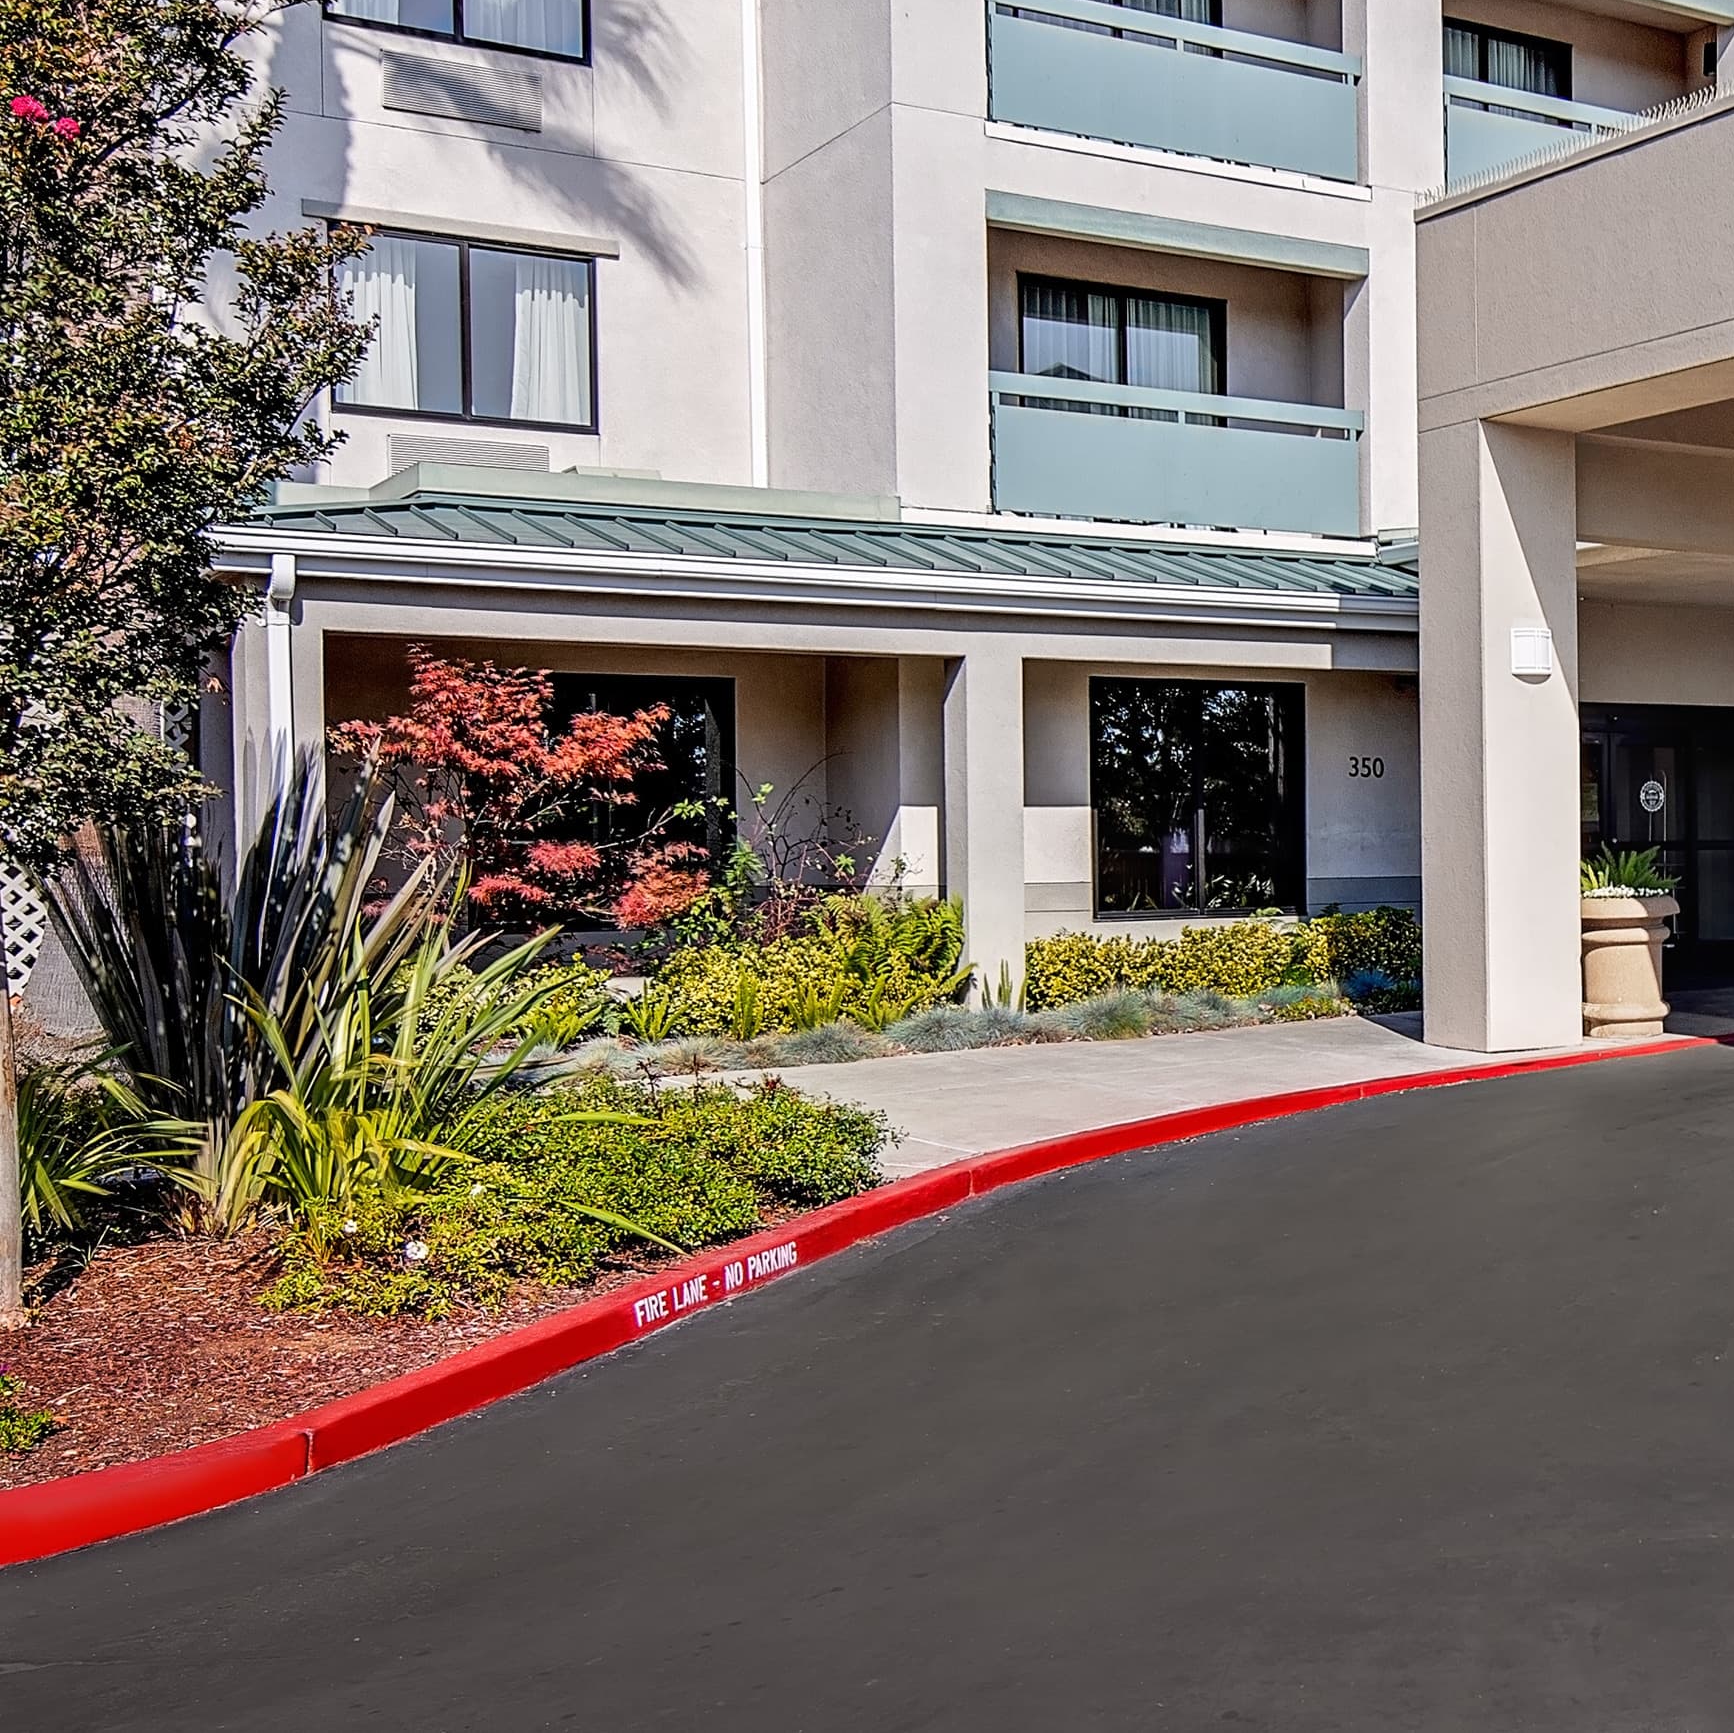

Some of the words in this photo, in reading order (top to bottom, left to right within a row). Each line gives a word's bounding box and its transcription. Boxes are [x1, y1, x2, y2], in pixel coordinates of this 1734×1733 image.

[1348, 756, 1385, 779] 350
[633, 1290, 669, 1328] FIRE
[672, 1274, 709, 1312] LANE
[723, 1263, 744, 1291] NO
[747, 1241, 798, 1281] PARKING
